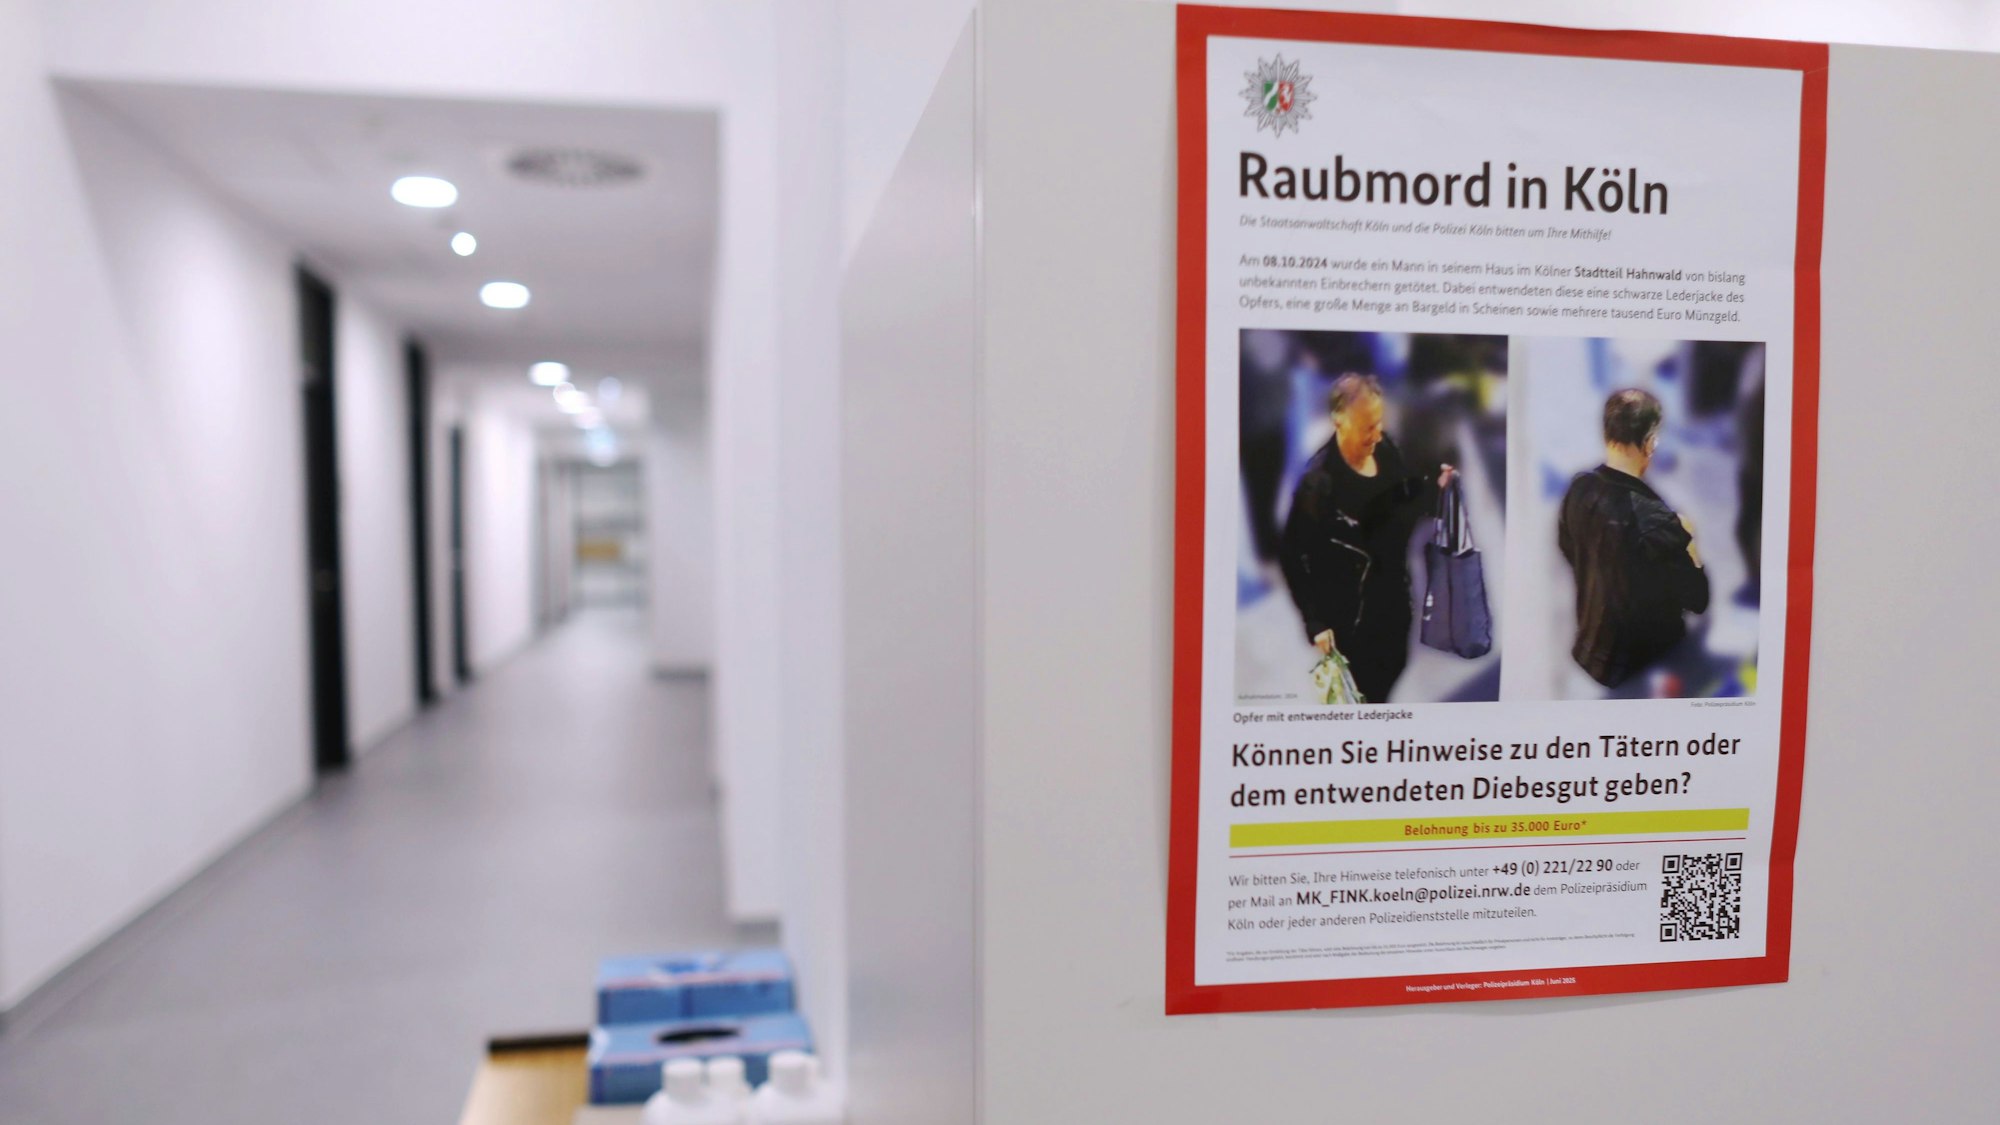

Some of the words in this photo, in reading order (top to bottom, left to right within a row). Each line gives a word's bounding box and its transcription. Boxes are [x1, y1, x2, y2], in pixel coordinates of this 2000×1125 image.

[1240, 151, 1491, 208] Raubmord
[1507, 162, 1547, 210] in
[1564, 166, 1668, 215] Köln
[1239, 214, 1257, 227] Die
[1260, 215, 1363, 234] Staatsanwaltschaft
[1364, 219, 1390, 232] Köln
[1392, 221, 1413, 234] und
[1414, 222, 1431, 234] die
[1432, 222, 1467, 236] Polizei
[1469, 224, 1494, 236] Köln
[1495, 225, 1526, 237] bitten
[1528, 229, 1545, 238] um
[1546, 226, 1569, 239] Ihre
[1569, 228, 1612, 243] Mithilfe!
[1240, 254, 1259, 266] Am
[1263, 255, 1328, 269] 08.10.2024
[1332, 258, 1367, 271] wurde
[1371, 259, 1388, 271] ein
[1392, 259, 1424, 272] Mann
[1428, 261, 1438, 272] in
[1442, 262, 1482, 274] seinem
[1486, 263, 1514, 276] Haus
[1517, 264, 1531, 276] im
[1535, 264, 1571, 277] Kölner
[1574, 265, 1623, 279] Stadtteil
[1626, 268, 1682, 281] Hahnwald
[1685, 273, 1704, 282] von
[1708, 271, 1745, 286] bislang
[1239, 275, 1318, 290] unbekannten
[1320, 276, 1391, 292] Einbrechern
[1393, 281, 1440, 296] getötet.
[1442, 281, 1476, 294] Dabei
[1478, 284, 1553, 297] entwendeten
[1555, 285, 1585, 298] diese
[1586, 286, 1611, 299] eine
[1612, 287, 1663, 301] schwarze
[1665, 288, 1724, 304] Lederjacke
[1725, 291, 1745, 303] des
[1239, 294, 1283, 310] Opfers,
[1285, 296, 1311, 310] eine
[1313, 297, 1349, 313] große
[1352, 298, 1392, 315] Menge
[1394, 302, 1409, 312] an
[1412, 300, 1456, 317] Bargeld
[1459, 302, 1470, 314] in
[1472, 301, 1524, 316] Scheinen
[1526, 304, 1559, 317] sowie
[1561, 306, 1608, 318] mehrere
[1610, 308, 1655, 320] tausend
[1656, 308, 1682, 320] Euro
[1685, 309, 1741, 325] Münzgeld.
[1233, 712, 1264, 725] Opfer
[1266, 712, 1285, 722] mit
[1287, 710, 1355, 722] entwendeter
[1357, 709, 1414, 722] Lederjacke
[1233, 743, 1332, 767] Können
[1342, 740, 1377, 765] Sie
[1387, 737, 1502, 763] Hinweise
[1510, 743, 1537, 760] zu
[1546, 735, 1590, 759] den
[1599, 735, 1679, 758] Tätern
[1687, 732, 1741, 756] oder
[1231, 783, 1285, 808] dem
[1295, 778, 1464, 805] entwendeten
[1473, 775, 1598, 804] Diebesgut
[1604, 771, 1691, 803] geben?
[1404, 824, 1469, 837] Belohnung
[1473, 822, 1491, 834] bis
[1493, 824, 1508, 833] zu
[1510, 821, 1551, 833] 35.000
[1228, 876, 1249, 886] Wir
[1252, 874, 1287, 886] bitten
[1290, 872, 1310, 884] Sie,
[1313, 872, 1337, 883] Ihre
[1340, 870, 1392, 882] Hinweise
[1394, 866, 1457, 880] telefonisch
[1459, 867, 1489, 878] unter
[1492, 862, 1518, 876] +49
[1521, 859, 1540, 877] (0)
[1543, 858, 1593, 875] 221/22
[1596, 858, 1614, 872] 90
[1615, 860, 1641, 871] oder
[1228, 900, 1247, 910] per
[1250, 896, 1275, 907] Mail
[1278, 898, 1293, 906] an
[1296, 882, 1531, 908] MK_FINK.koeln@polizei.nrw.de
[1533, 885, 1557, 896] dem
[1560, 880, 1648, 895] Polizeipräsidium
[1227, 918, 1255, 930] Köln
[1258, 917, 1286, 929] oder
[1286, 915, 1318, 931] jeder
[1319, 914, 1366, 927] anderen
[1368, 909, 1470, 924] Polizeidienststelle
[1472, 906, 1538, 919] mitzuteilen.
